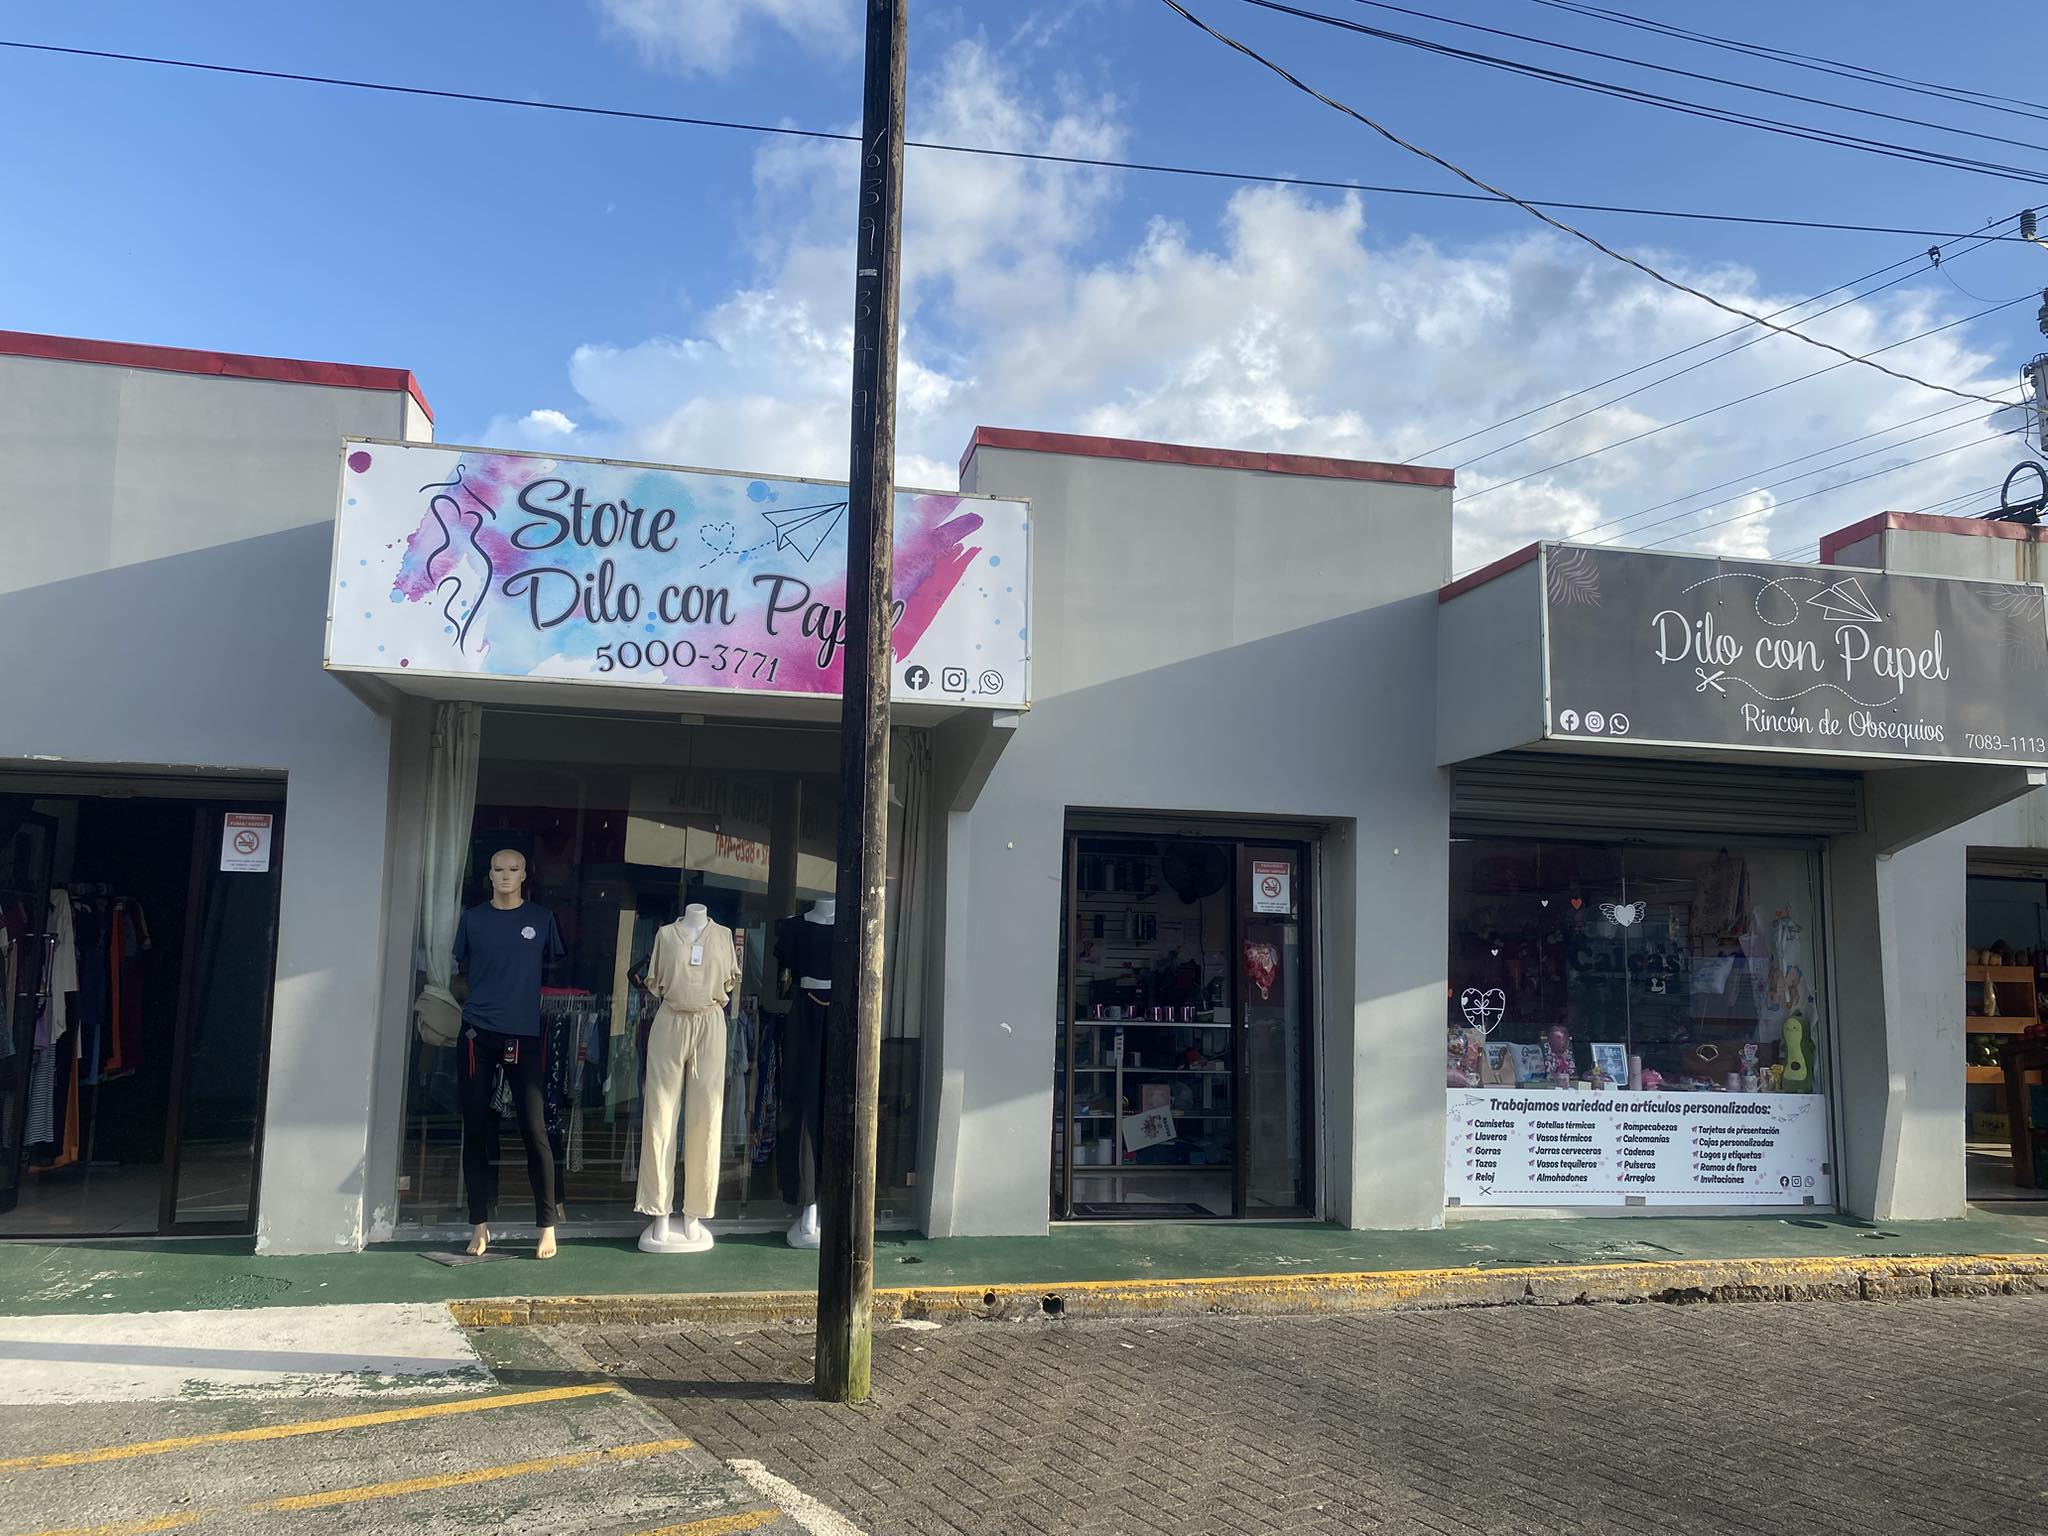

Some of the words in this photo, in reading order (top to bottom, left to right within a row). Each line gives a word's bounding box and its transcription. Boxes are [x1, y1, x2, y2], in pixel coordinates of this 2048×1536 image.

[510, 478, 679, 554] Store
[501, 559, 645, 632] Dilo
[656, 579, 737, 627] con
[1651, 609, 1743, 666] Dilo
[1755, 635, 1825, 673] con
[1834, 624, 1950, 694] Papel
[594, 639, 780, 684] 5000-3771
[1740, 702, 1814, 735] Rincón
[1818, 713, 1843, 736] de
[1847, 710, 1945, 745] Obsequios
[1965, 733, 2046, 753] 7083-1113
[1490, 1098, 1559, 1114] Trabajamos
[1562, 1100, 1614, 1112] variedad
[1614, 1102, 1629, 1112] en
[1630, 1100, 1681, 1114] artículos
[1683, 1101, 1771, 1116] personalizados:
[1474, 1119, 1515, 1129] Camisetas
[1536, 1120, 1565, 1129] Botellas
[1565, 1121, 1596, 1130] térmicas
[1622, 1122, 1678, 1132] Rompecabezas
[1699, 1126, 1726, 1135] Tarjetas
[1726, 1126, 1736, 1134] de
[1736, 1126, 1780, 1136] presentación
[1474, 1132, 1508, 1141] Llaveros
[1536, 1133, 1559, 1142] Vasos
[1559, 1133, 1592, 1142] térmicos
[1623, 1133, 1670, 1143] Calcomanías
[1699, 1138, 1719, 1147] Cajas
[1719, 1138, 1774, 1147] personalizadas
[1474, 1146, 1501, 1155] Gorras
[1535, 1146, 1560, 1155] Jarras
[1623, 1148, 1655, 1157] Cadenas
[1700, 1151, 1721, 1160] Logos
[1728, 1151, 1762, 1160] etiquetas
[1475, 1160, 1497, 1168] Tazas
[1536, 1160, 1559, 1168] Vasos
[1560, 1160, 1597, 1170] tequileros
[1624, 1160, 1656, 1169] Pulseras
[1700, 1163, 1726, 1172] Ramos
[1726, 1163, 1736, 1172] de
[1736, 1163, 1757, 1172] flores
[1475, 1172, 1495, 1183] Reloj
[1536, 1173, 1588, 1182] Almohadones
[1624, 1173, 1656, 1184] Arreglos
[1700, 1174, 1745, 1184] Invitaciones
